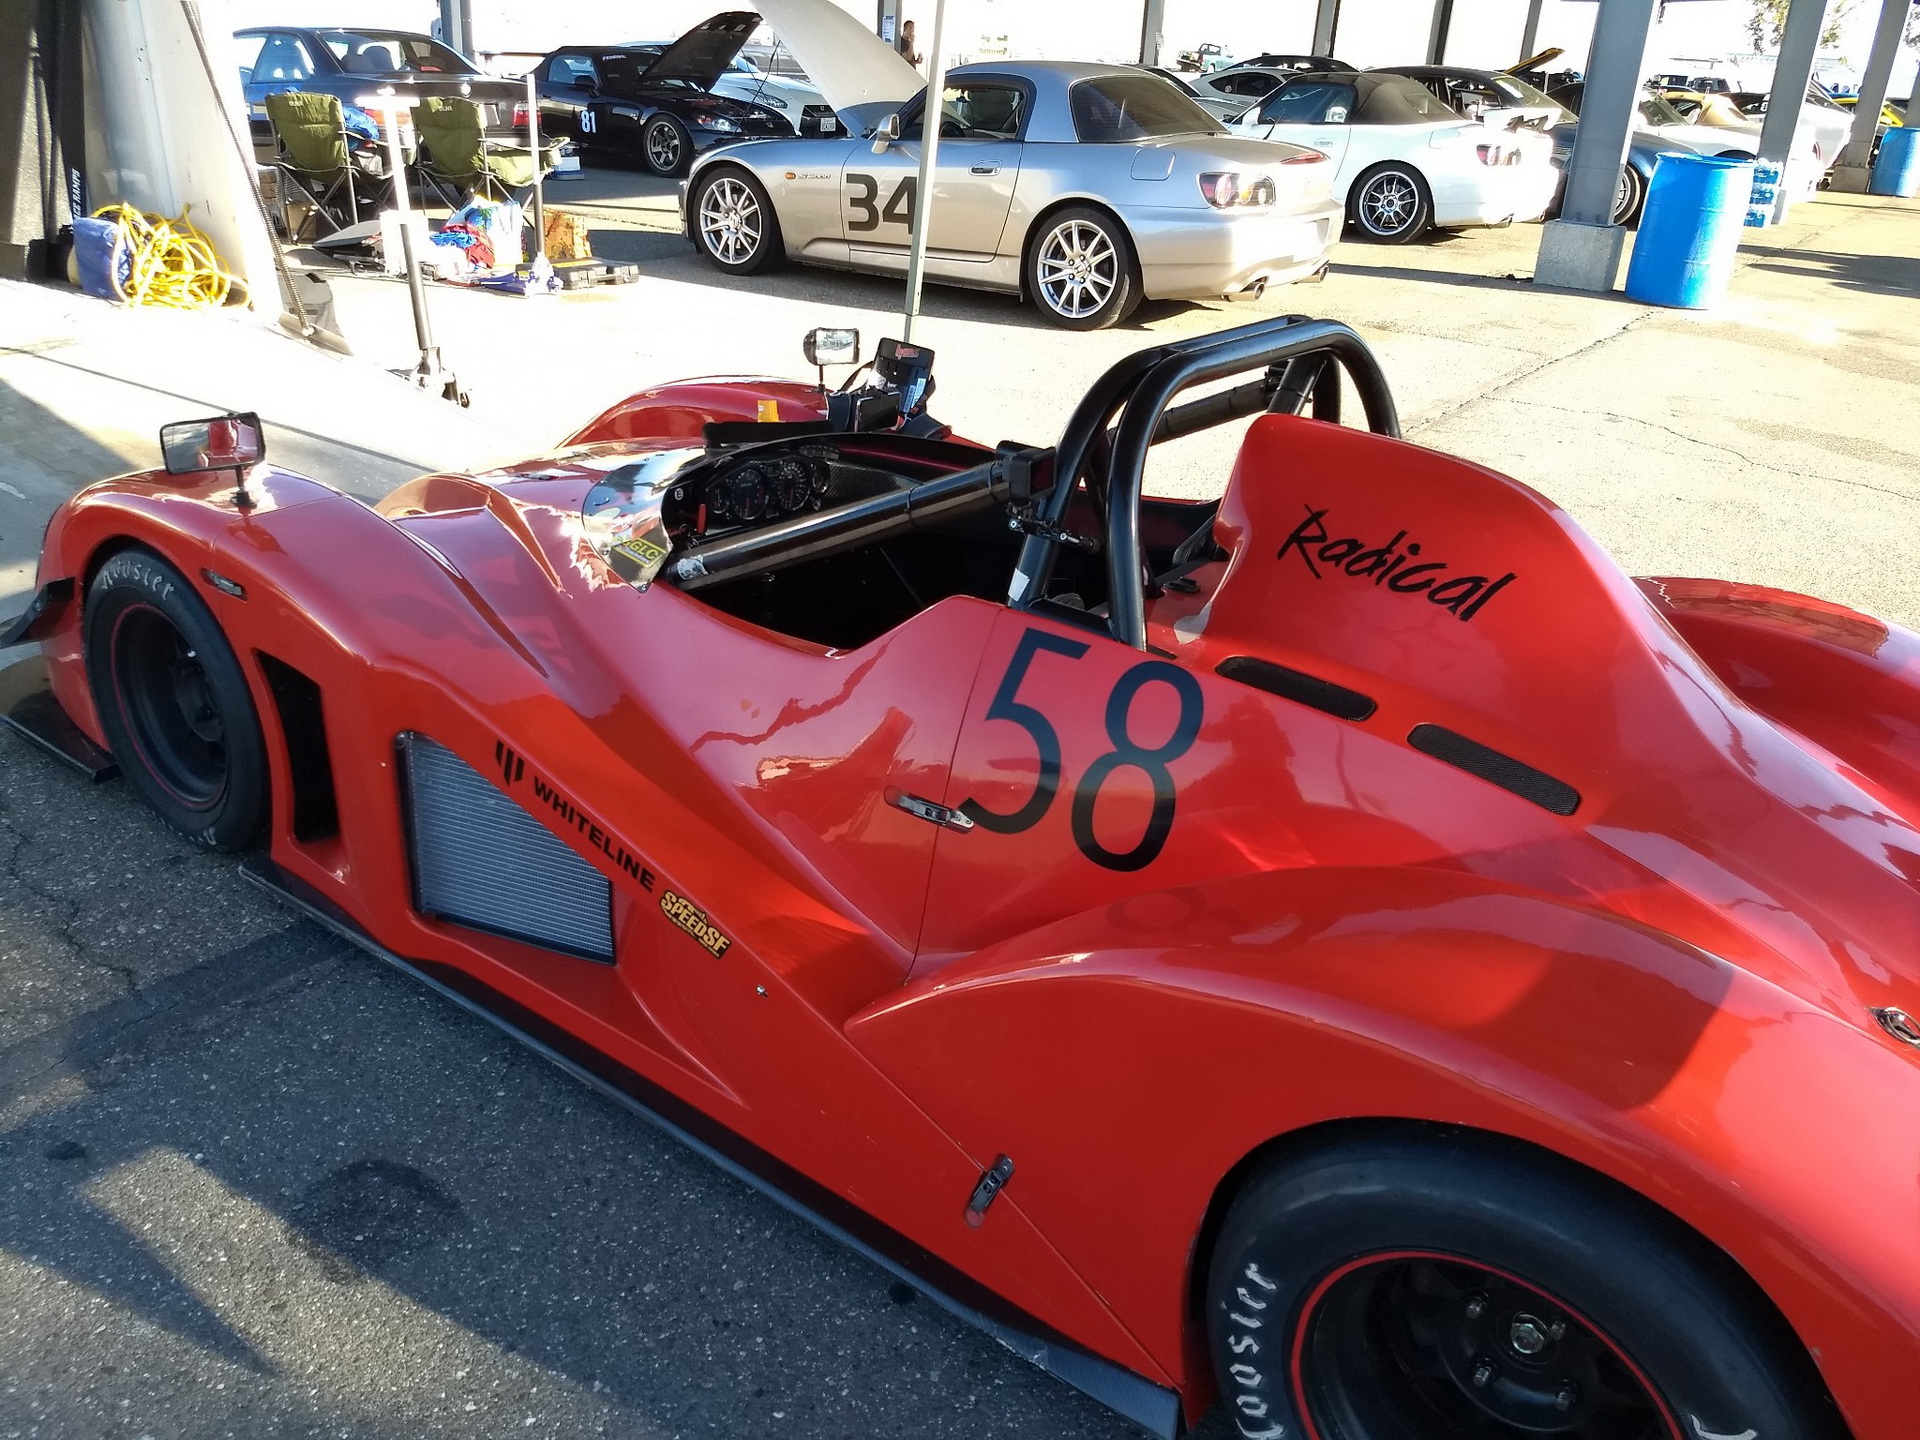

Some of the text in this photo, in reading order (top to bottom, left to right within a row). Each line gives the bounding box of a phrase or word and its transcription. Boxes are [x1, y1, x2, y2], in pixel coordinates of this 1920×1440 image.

[581, 110, 597, 133] 81
[72, 168, 81, 203] RAMPS
[846, 173, 918, 234] 34
[1277, 504, 1518, 622] Radical
[957, 627, 1204, 872] 58
[534, 776, 656, 893] WHITELINE
[660, 891, 731, 951] SPEEDSF
